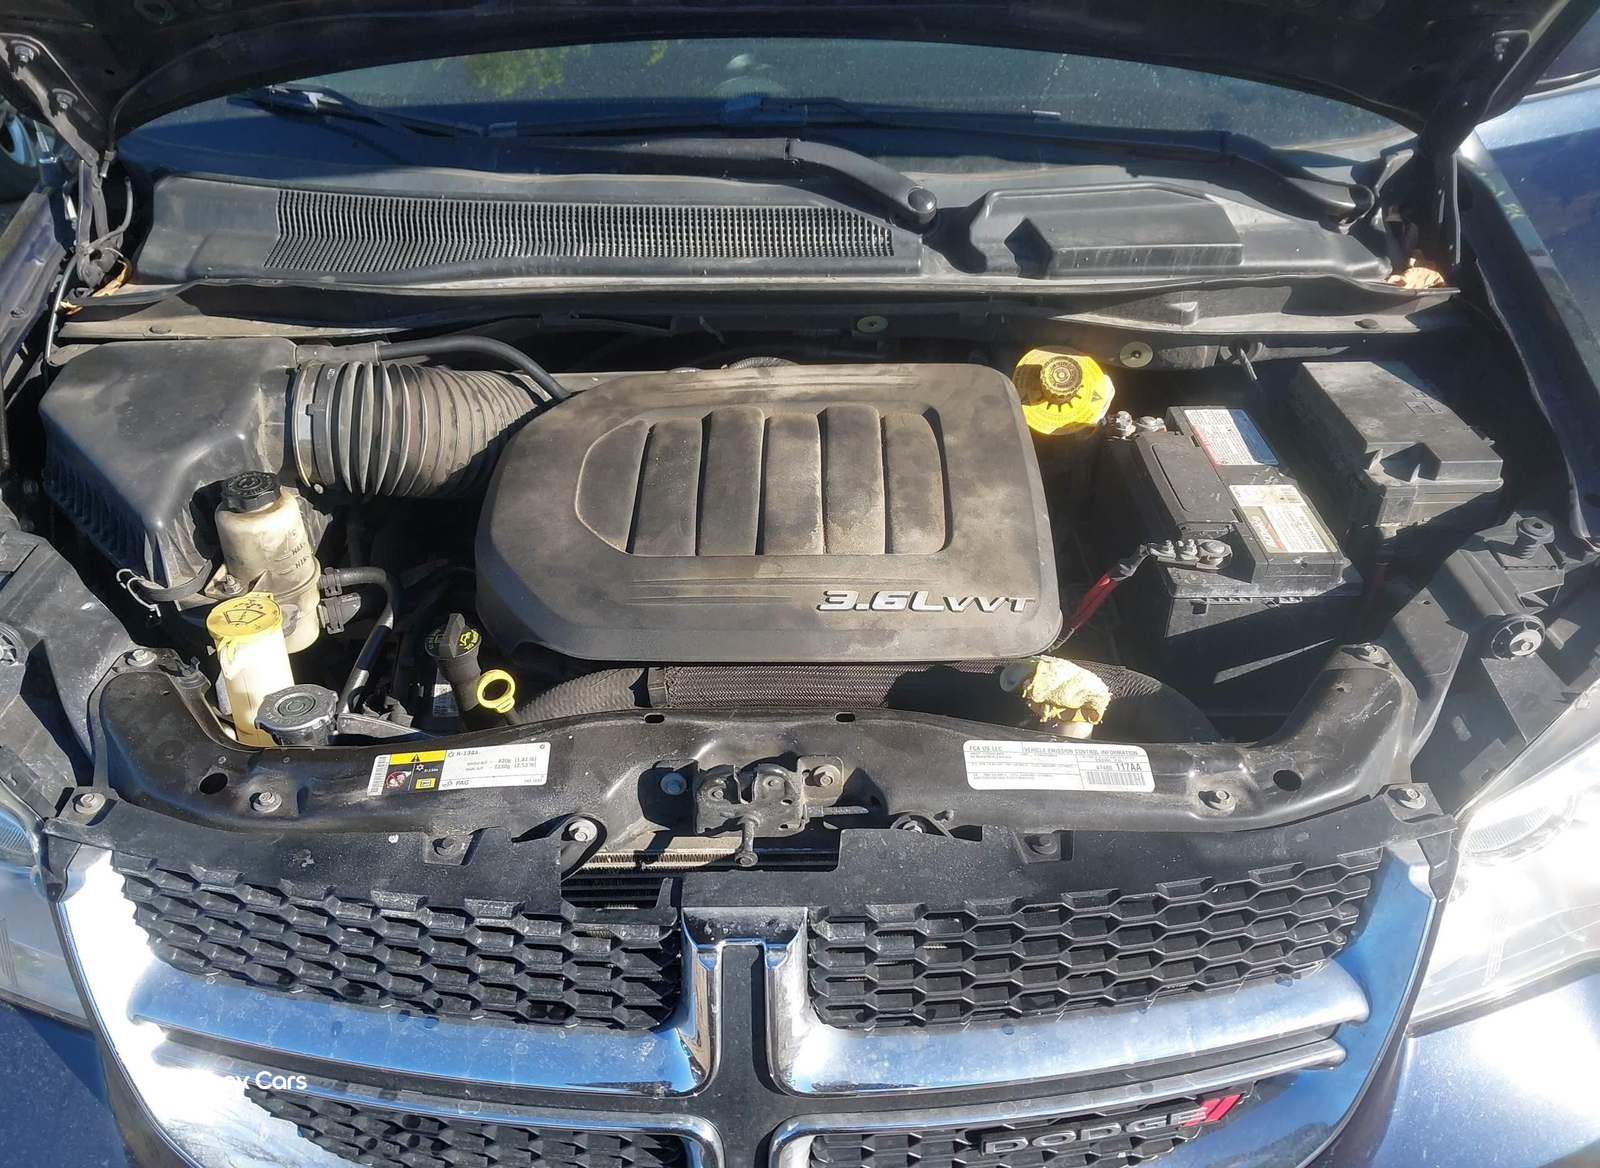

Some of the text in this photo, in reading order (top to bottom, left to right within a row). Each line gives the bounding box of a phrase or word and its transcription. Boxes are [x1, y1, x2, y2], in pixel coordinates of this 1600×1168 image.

[456, 750, 479, 758] R-134a
[1115, 762, 1142, 771] 117AA
[981, 1106, 1208, 1156] DODGE
